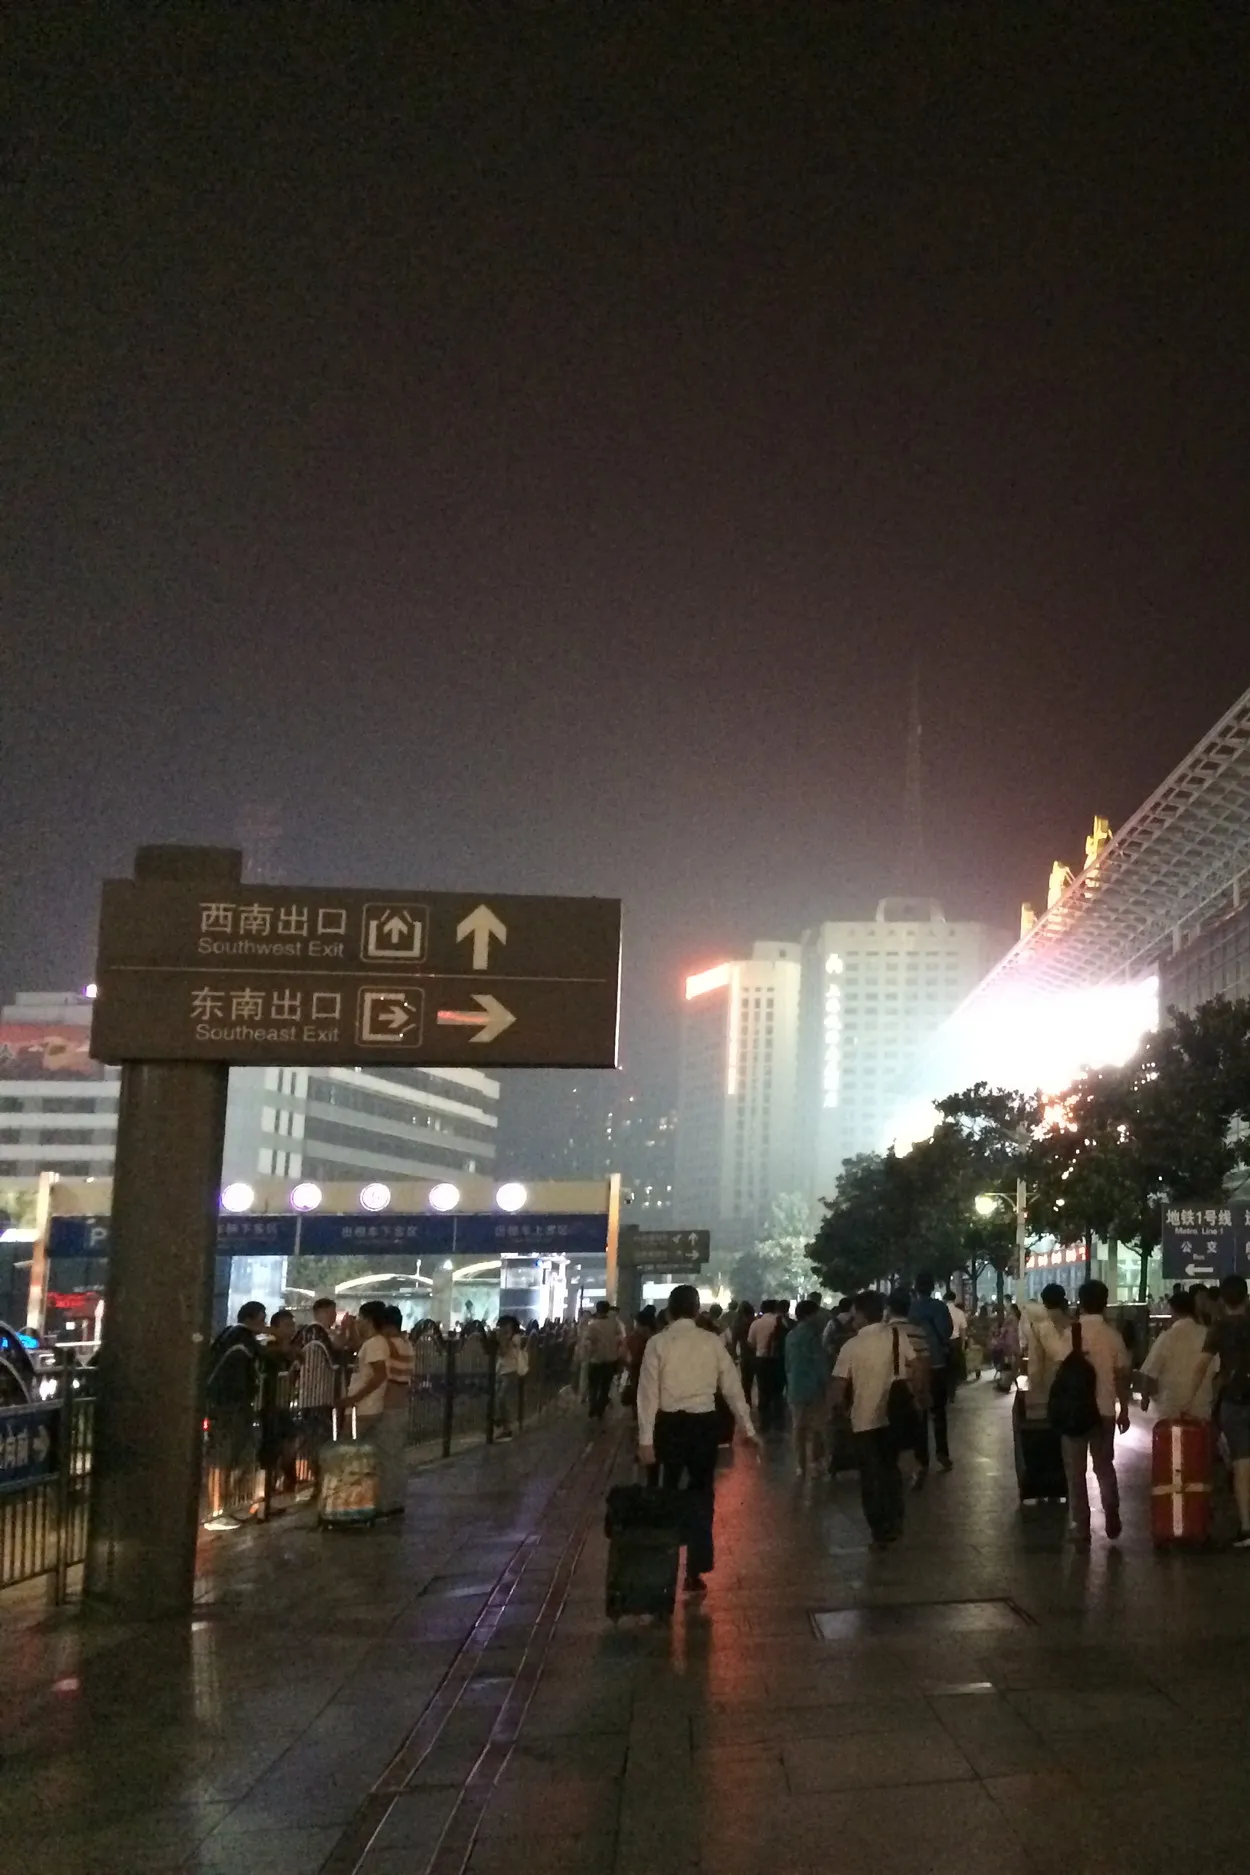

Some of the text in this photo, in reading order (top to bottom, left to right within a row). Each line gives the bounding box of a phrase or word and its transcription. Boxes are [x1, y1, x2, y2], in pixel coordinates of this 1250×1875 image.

[200, 903, 348, 938] 西南出口
[198, 938, 345, 958] Southwest Exit
[191, 986, 342, 1022] 东南出口
[196, 1024, 340, 1043] Southeast Exit
[1166, 1209, 1232, 1226] 地铁1号线
[1175, 1227, 1198, 1235] Metro
[1201, 1227, 1218, 1235] Line
[1181, 1241, 1218, 1253] 公交
